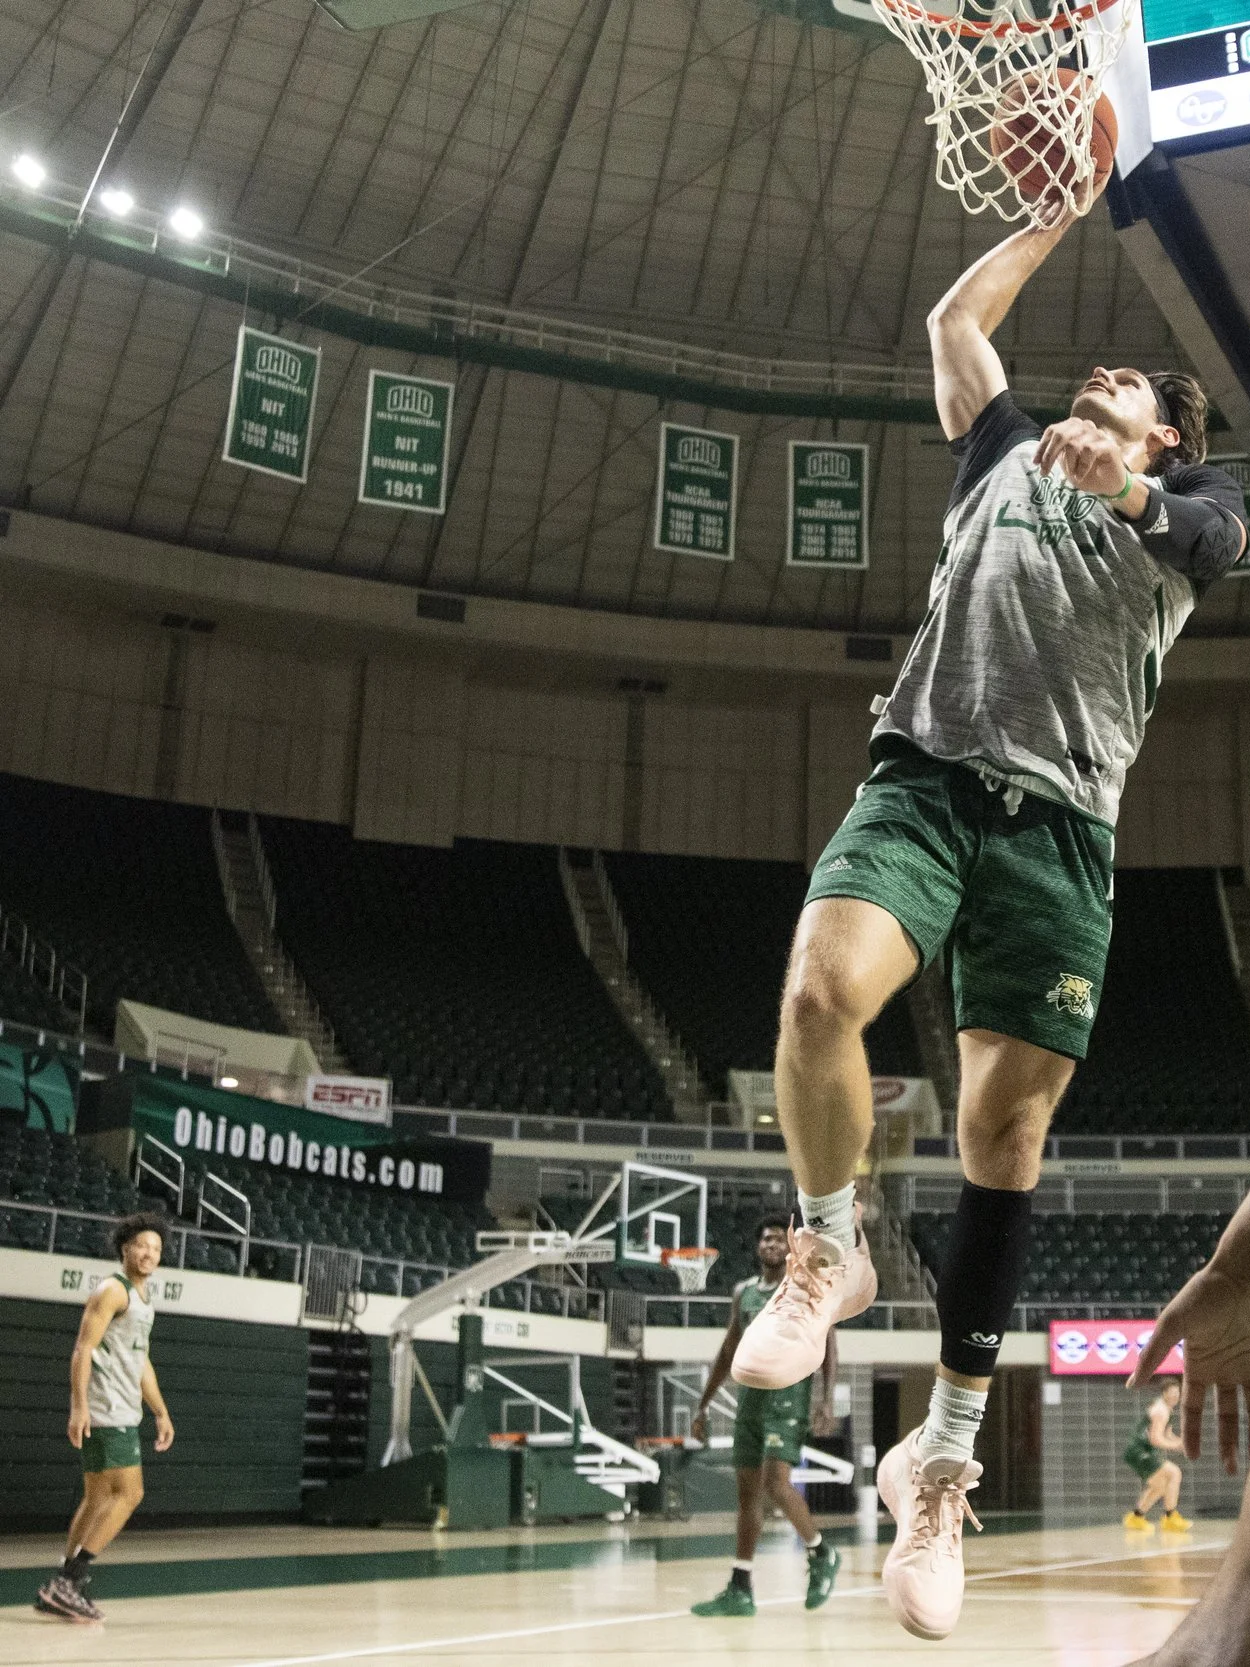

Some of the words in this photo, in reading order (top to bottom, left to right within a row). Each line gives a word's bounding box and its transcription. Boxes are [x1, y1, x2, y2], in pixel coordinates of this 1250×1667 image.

[256, 346, 301, 383] OHIO
[261, 397, 285, 417] NIT
[388, 385, 434, 418] OHIO
[394, 436, 419, 452] NIT
[678, 437, 721, 469] OHIO
[371, 456, 437, 474] RUNNER-UP
[807, 452, 850, 480] OHIO
[383, 479, 423, 499] 1941
[796, 508, 860, 519] TOURNAMENT
[313, 1084, 382, 1108] ESPN
[174, 1106, 444, 1194] OhioBobcats.com
